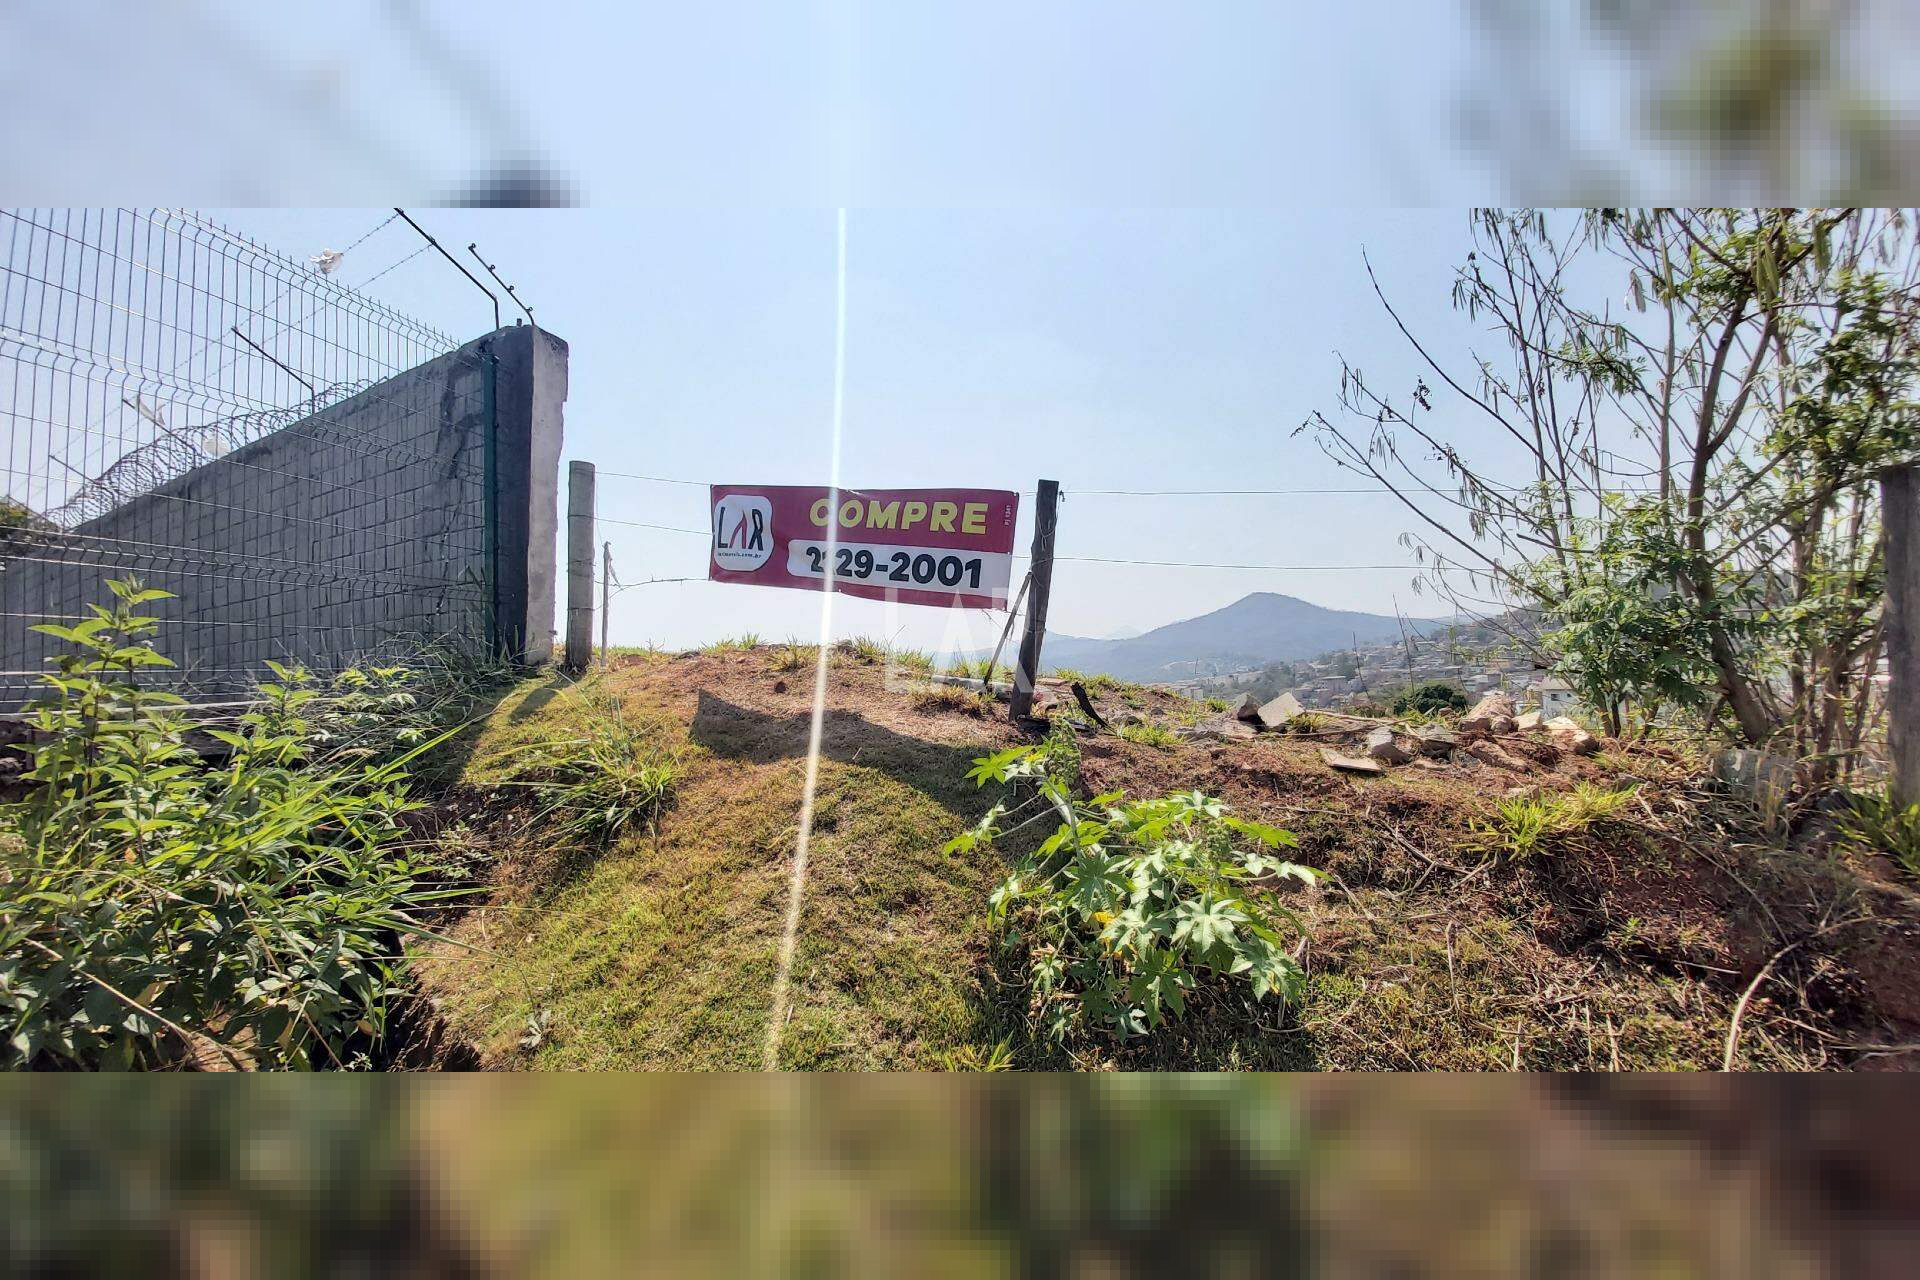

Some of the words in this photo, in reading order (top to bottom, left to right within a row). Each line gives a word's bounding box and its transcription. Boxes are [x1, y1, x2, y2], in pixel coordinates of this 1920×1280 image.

[717, 507, 764, 551] LAR
[809, 499, 988, 534] COMPRE
[806, 546, 982, 588] 229-2001
